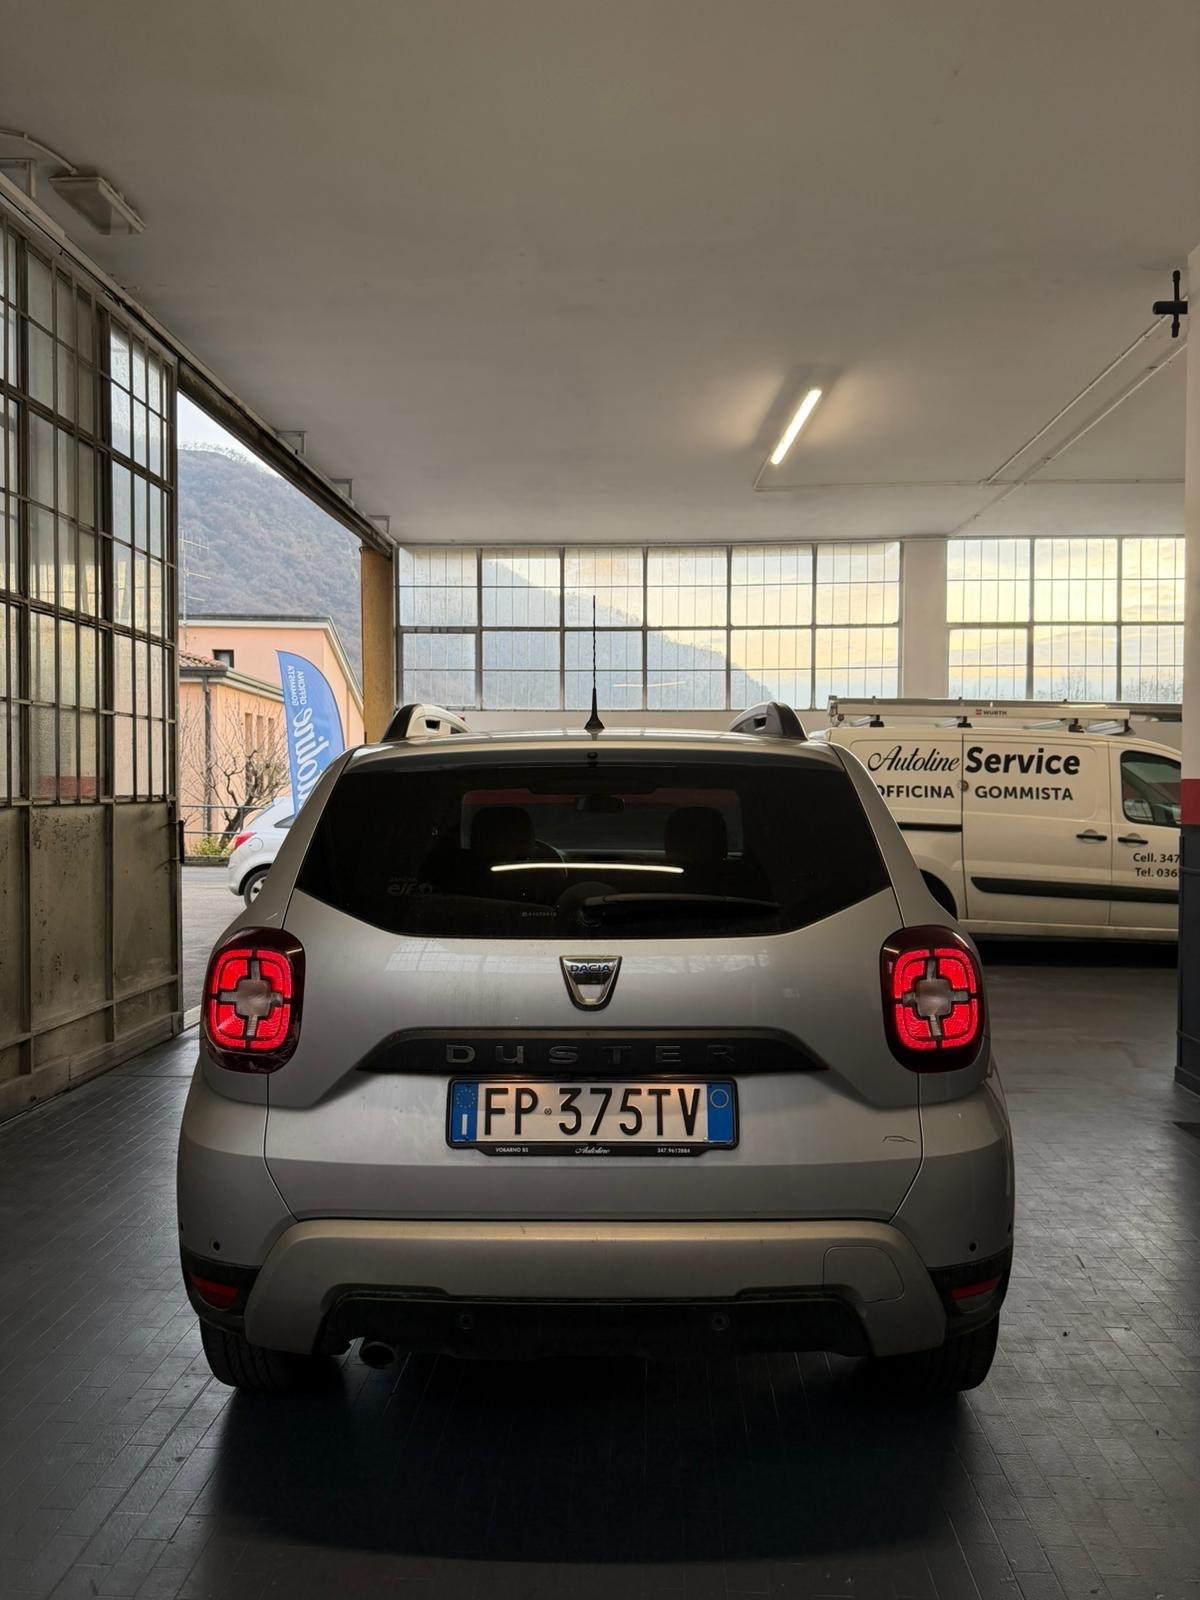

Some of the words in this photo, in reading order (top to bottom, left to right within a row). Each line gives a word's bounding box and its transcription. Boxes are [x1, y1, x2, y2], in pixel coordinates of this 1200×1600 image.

[867, 745, 960, 772] Autoline
[965, 746, 1080, 775] Service
[975, 785, 1073, 801] GOMMISTA
[1133, 852, 1157, 863] Cell.
[1135, 867, 1154, 877] Tel.
[570, 964, 611, 973] DACIA
[446, 1044, 737, 1065] DUSTER
[484, 1087, 539, 1136] FP
[558, 1087, 701, 1136] 375TV
